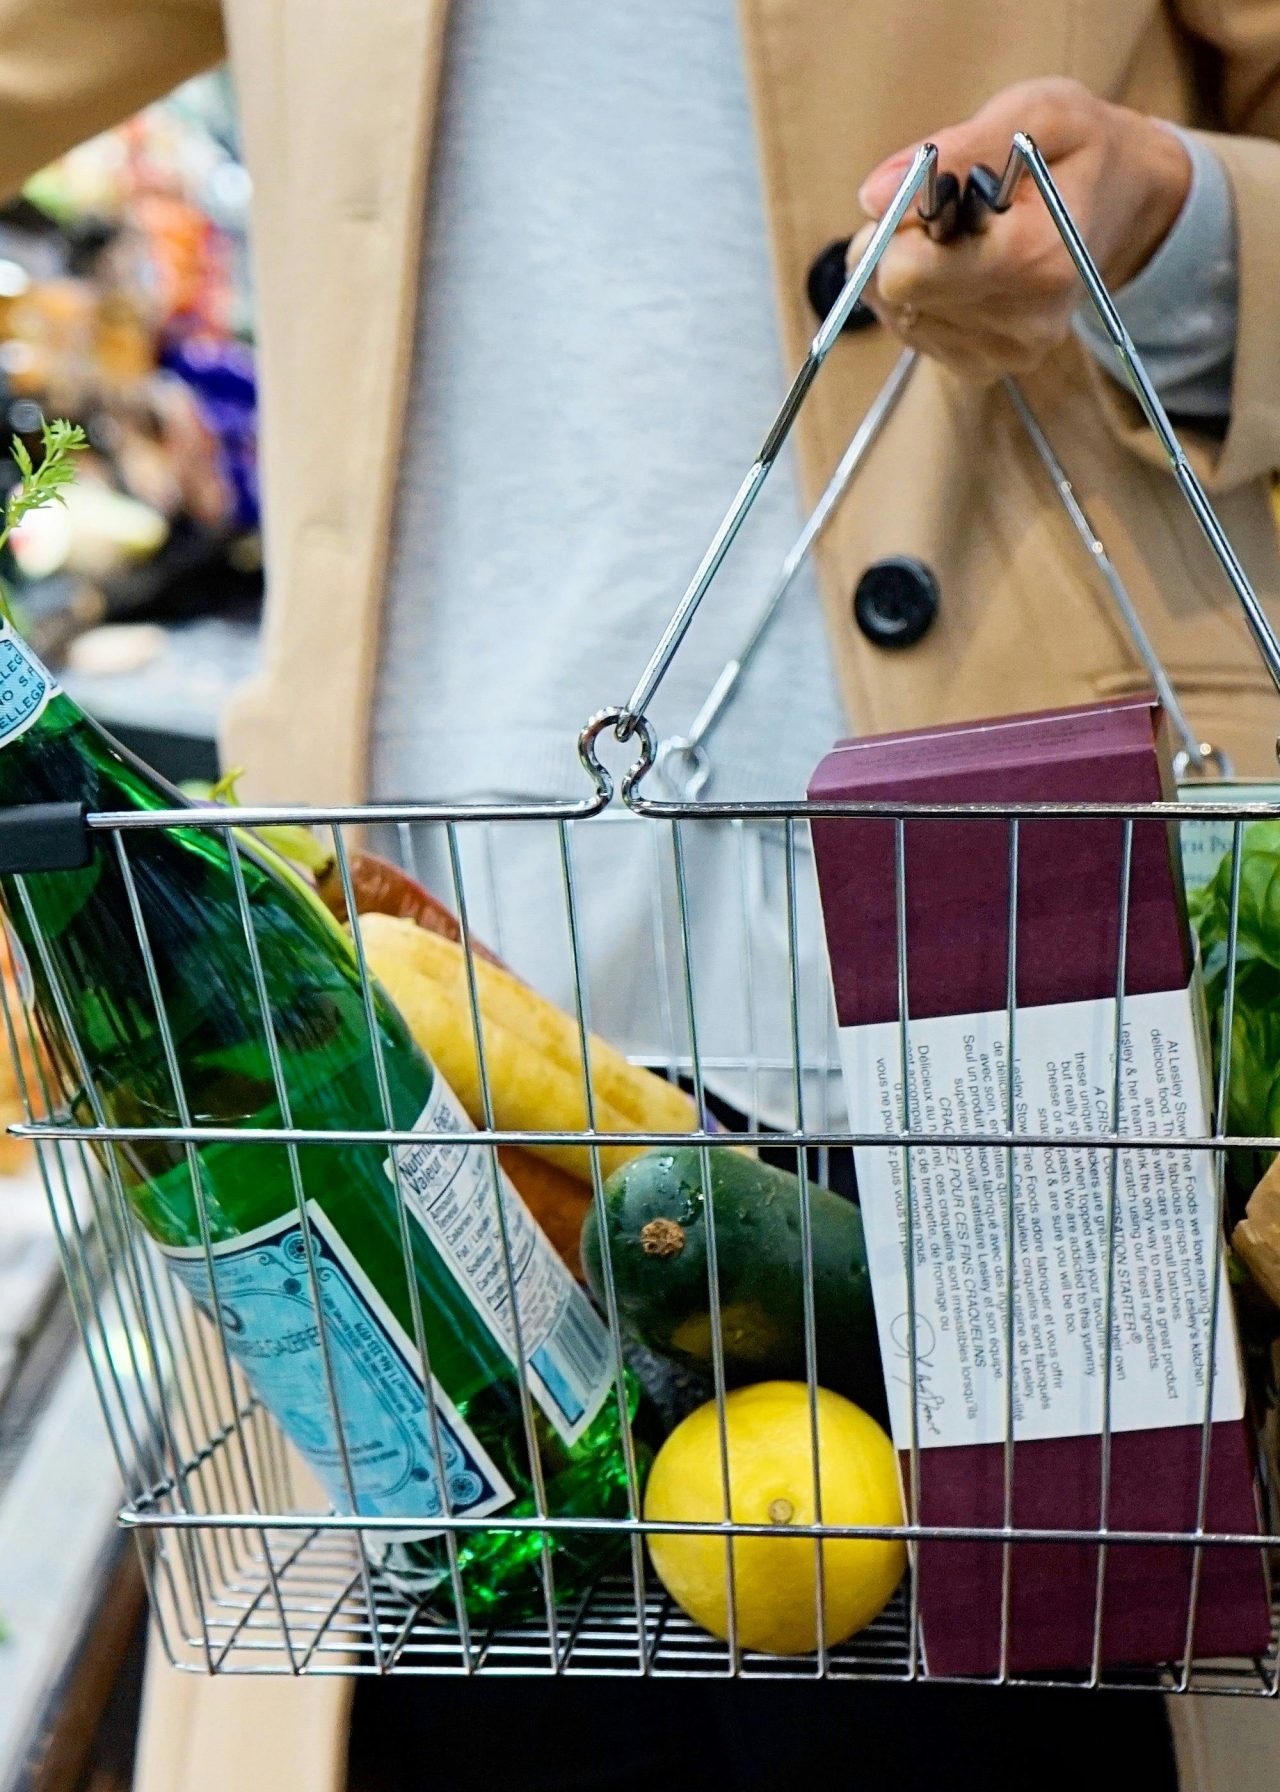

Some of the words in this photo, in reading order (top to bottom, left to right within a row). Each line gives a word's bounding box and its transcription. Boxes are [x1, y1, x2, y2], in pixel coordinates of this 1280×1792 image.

[963, 1034, 976, 1062] Seul
[993, 1041, 1004, 1056] de
[1150, 1028, 1164, 1083] delicious
[1166, 1039, 1178, 1053] At
[876, 1058, 887, 1087] vous
[917, 1045, 932, 1101] Délicieux
[967, 1066, 976, 1081] un
[980, 1053, 991, 1082] avec
[1061, 1060, 1073, 1080] but
[1075, 1052, 1086, 1086] these
[1125, 1066, 1136, 1076] &
[1169, 1056, 1182, 1098] Lesley
[880, 1090, 889, 1106] ne
[1046, 1061, 1059, 1106] cheese
[1093, 1085, 1105, 1096] A
[1127, 1080, 1138, 1101] her
[925, 1105, 935, 1120] au
[967, 1085, 985, 1128] produit
[984, 1086, 996, 1115] soin,
[1064, 1084, 1077, 1117] really
[1079, 1090, 1092, 1131] unique
[1144, 1097, 1154, 1117] are
[1158, 1087, 1171, 1117] food.
[988, 1119, 997, 1134] en
[1053, 1110, 1061, 1122] or
[1130, 1104, 1142, 1137] team
[409, 1156, 442, 1194] Valeur
[887, 1160, 900, 1185] plus
[917, 1158, 928, 1174] de
[961, 1147, 978, 1191] pouvait
[1073, 1157, 1085, 1190] when
[1122, 1158, 1138, 1202] scratch
[1152, 1160, 1165, 1184] with
[934, 1173, 944, 1195] ces
[948, 1167, 964, 1208] POUR
[1025, 1176, 1039, 1213] Foods
[1047, 1177, 1057, 1186] &
[1139, 1173, 1151, 1193] the
[1167, 1162, 1181, 1214] fabulous
[1184, 1175, 1198, 1214] Foods
[893, 1189, 904, 1217] vous
[920, 1178, 936, 1239] trempette,
[982, 1180, 998, 1229] fabriqué
[1048, 1190, 1058, 1210] are
[1063, 1188, 1074, 1209] We
[1093, 1191, 1102, 1211] are
[1141, 1197, 1155, 1222] only
[1156, 1188, 1167, 1215] care
[954, 1211, 968, 1240] CES
[969, 1194, 985, 1250] satisfaire
[1014, 1202, 1028, 1253] fabuleux
[1052, 1214, 1062, 1242] sure
[1066, 1213, 1076, 1232] are
[1077, 1194, 1093, 1235] topped
[1129, 1206, 1141, 1239] using
[1160, 1219, 1170, 1230] in
[1190, 1218, 1199, 1235] we
[937, 1199, 954, 1261] craquelins
[1031, 1217, 1042, 1252] adore
[1145, 1225, 1157, 1250] way
[1175, 1218, 1187, 1254] crisps
[913, 1233, 924, 1266] nous,
[928, 1242, 939, 1258] de
[958, 1243, 973, 1275] FINS
[989, 1233, 1000, 1262] avec
[1053, 1245, 1065, 1267] you
[1084, 1239, 1097, 1264] with
[1133, 1242, 1143, 1262] our
[1149, 1253, 1160, 1265] to
[1162, 1234, 1176, 1267] small
[1193, 1239, 1203, 1265] love
[977, 1253, 990, 1293] Lesley
[993, 1265, 1004, 1287] des
[1069, 1236, 1086, 1289] addicted
[1180, 1258, 1191, 1286] from
[931, 1262, 945, 1312] fromage
[946, 1265, 960, 1291] sont
[1021, 1257, 1038, 1320] craquelins
[1036, 1256, 1050, 1311] fabriquer
[1059, 1271, 1071, 1290] will
[1085, 1268, 1098, 1294] your
[1136, 1265, 1150, 1298] finest
[1151, 1269, 1165, 1303] make
[1197, 1268, 1210, 1313] making
[983, 1296, 994, 1308] et
[1062, 1293, 1072, 1309] be
[1077, 1292, 1087, 1304] to
[1156, 1306, 1165, 1314] a
[1167, 1271, 1181, 1322] batches.
[938, 1315, 947, 1331] ou
[950, 1295, 967, 1362] irrésistibles
[962, 1278, 985, 1368] CRAQUELINS
[985, 1311, 995, 1333] son
[1011, 1293, 1025, 1337] cuisine
[1043, 1314, 1055, 1325] et
[1064, 1313, 1074, 1333] too.
[1079, 1307, 1090, 1329] this
[1184, 1290, 1199, 1339] Lesley's
[1017, 1340, 1028, 1356] de
[1030, 1323, 1043, 1349] sont
[1045, 1329, 1056, 1358] vous
[1110, 1325, 1123, 1350] their
[1140, 1302, 1159, 1371] ingredients.
[1155, 1318, 1172, 1349] great
[987, 1337, 1001, 1382] équipe.
[1079, 1332, 1095, 1377] yummy
[1114, 1355, 1125, 1380] own
[1191, 1342, 1205, 1386] kitchen
[1020, 1359, 1033, 1401] Lesley.
[1034, 1353, 1050, 1409] fabriqués
[1050, 1361, 1062, 1389] offrir
[1160, 1353, 1179, 1399] product
